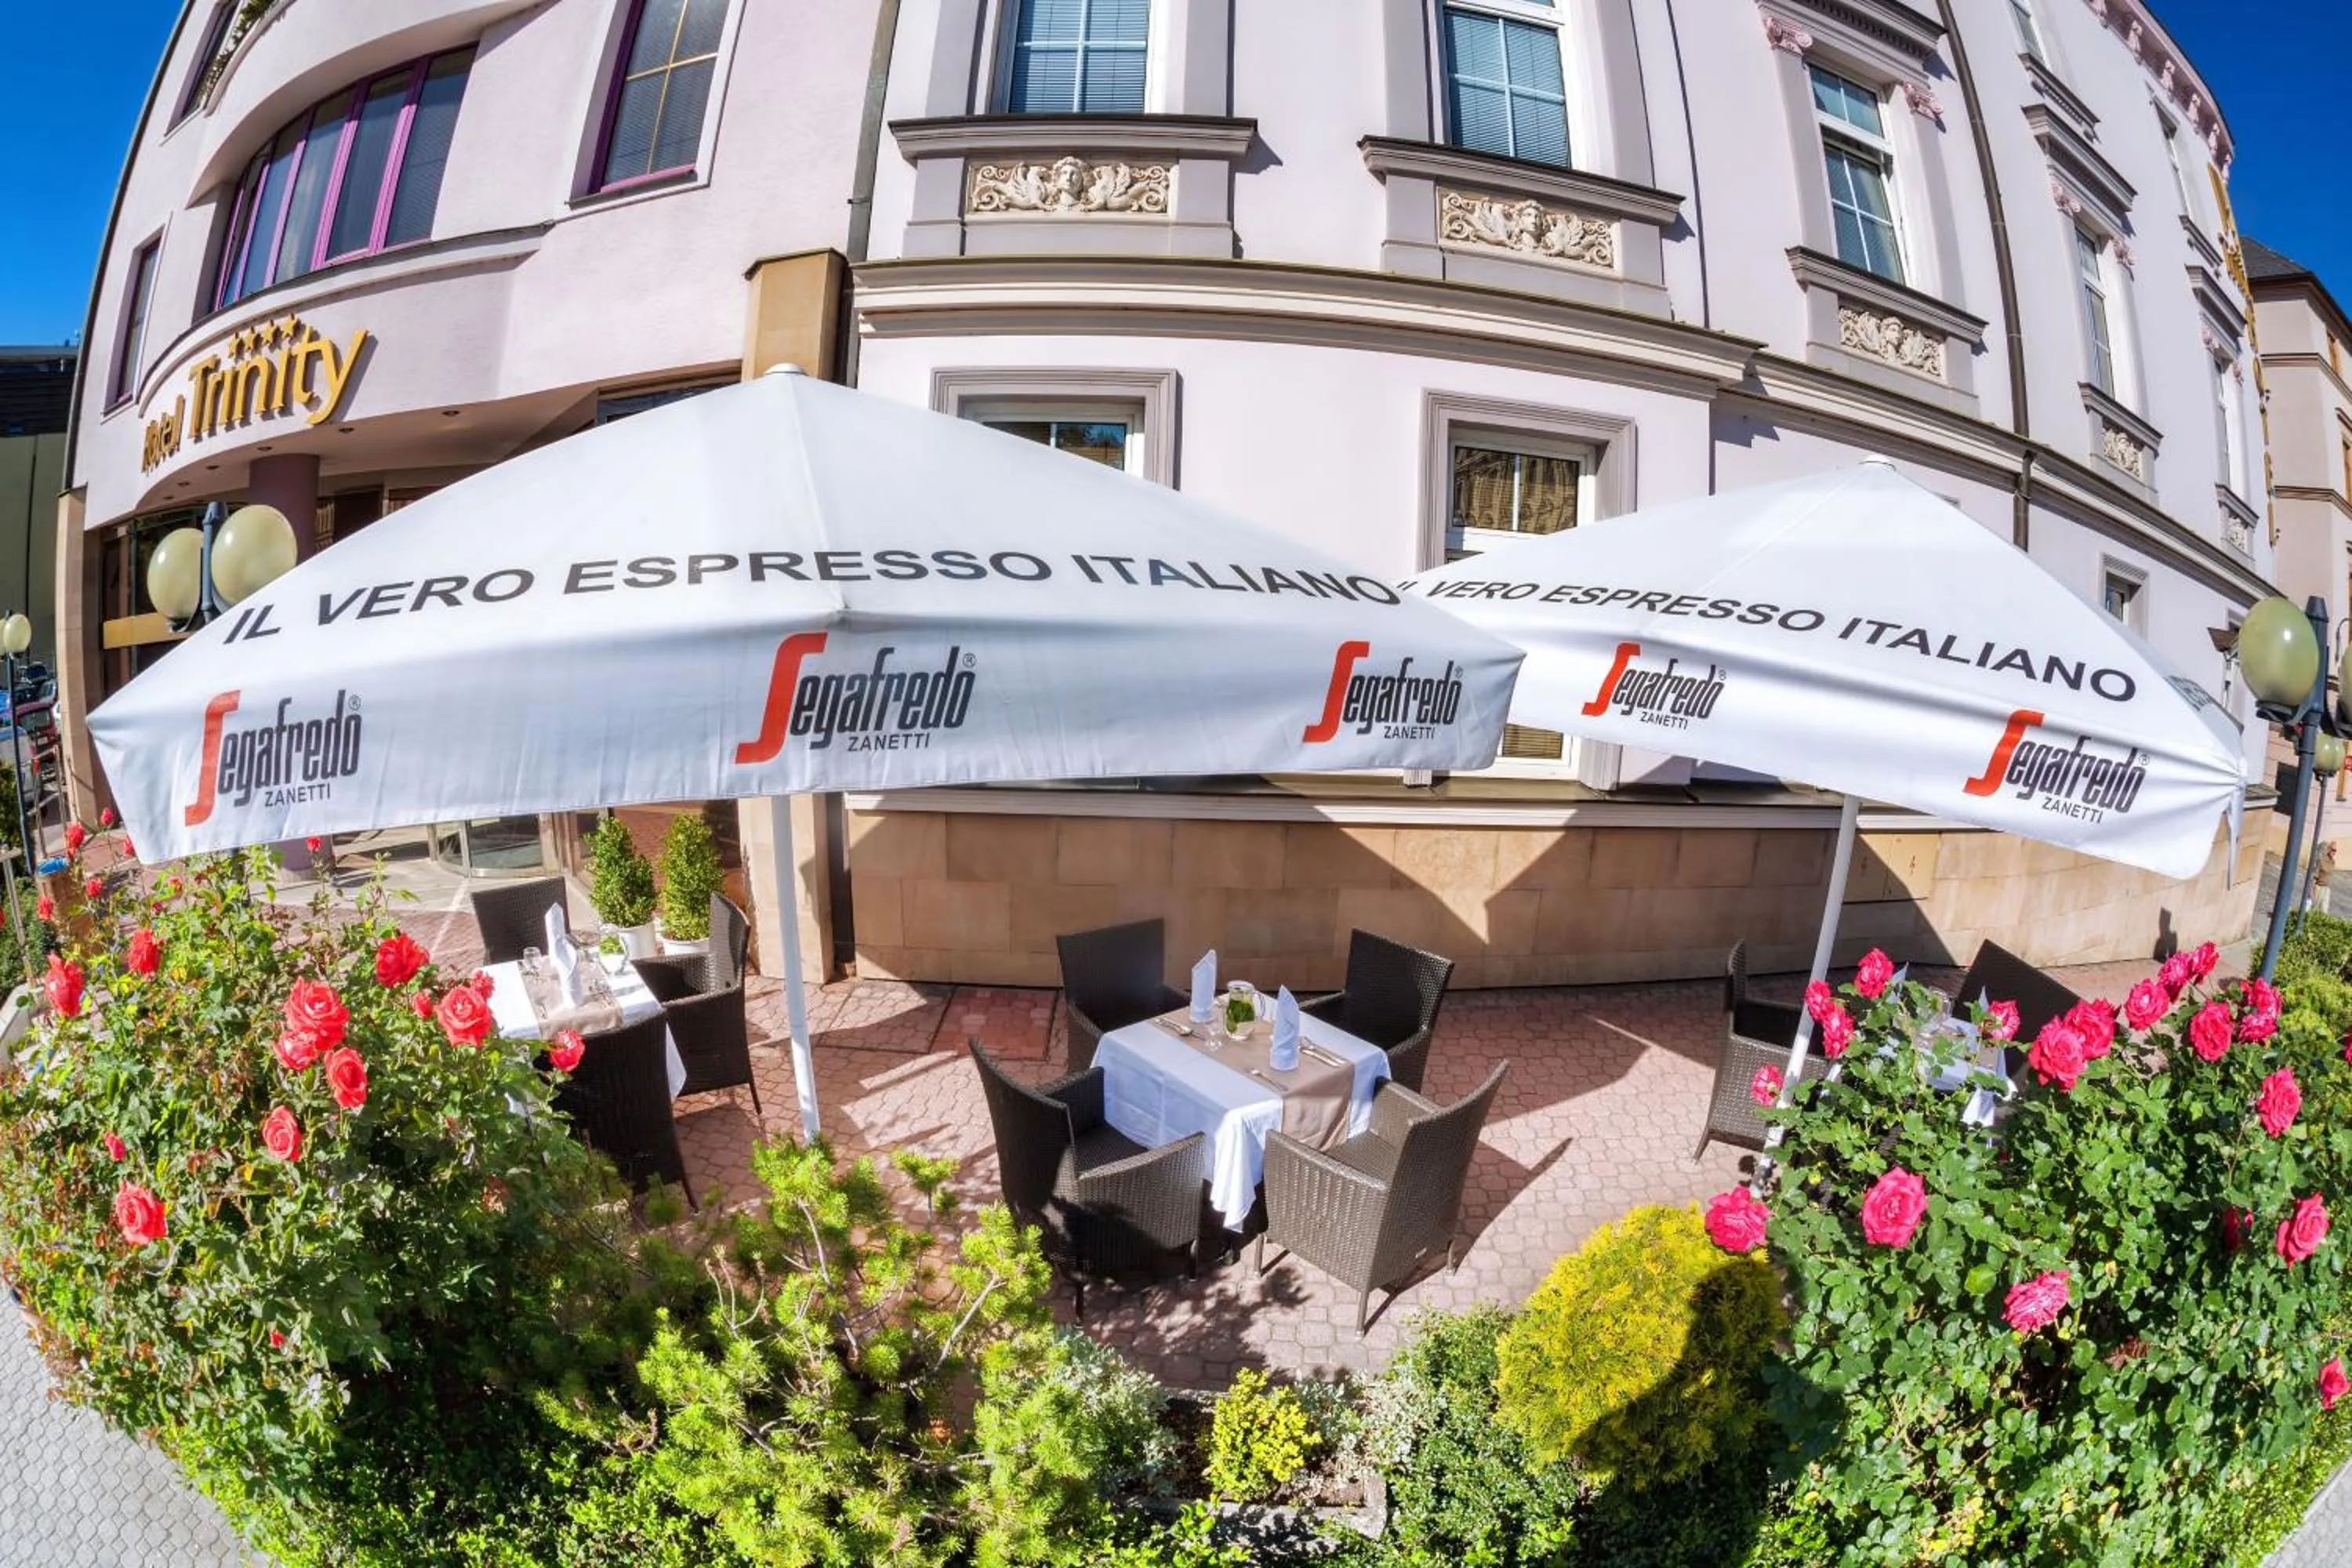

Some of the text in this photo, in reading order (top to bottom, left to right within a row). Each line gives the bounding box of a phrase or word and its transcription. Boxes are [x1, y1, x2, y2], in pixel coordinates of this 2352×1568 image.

[187, 325, 369, 440] Trinity
[223, 550, 1401, 644] IL VERO ESPRESSO ITALIANO
[1427, 581, 1540, 600] VERO
[1539, 584, 1825, 630] ESPRESSO
[1838, 617, 2136, 702] ITALIANO
[735, 632, 977, 764] Segafredo
[1302, 641, 1463, 743] Segafredo
[1581, 642, 1725, 717] Segafredo
[1639, 710, 1690, 730] ZANETTI
[185, 689, 362, 826] Segafredo
[847, 733, 931, 753] ZANETTI
[1383, 724, 1436, 740] ZANETTI
[1963, 709, 2147, 815] Segafredo
[263, 783, 331, 808] ZANETTI
[2041, 796, 2104, 825] ZANETTI
